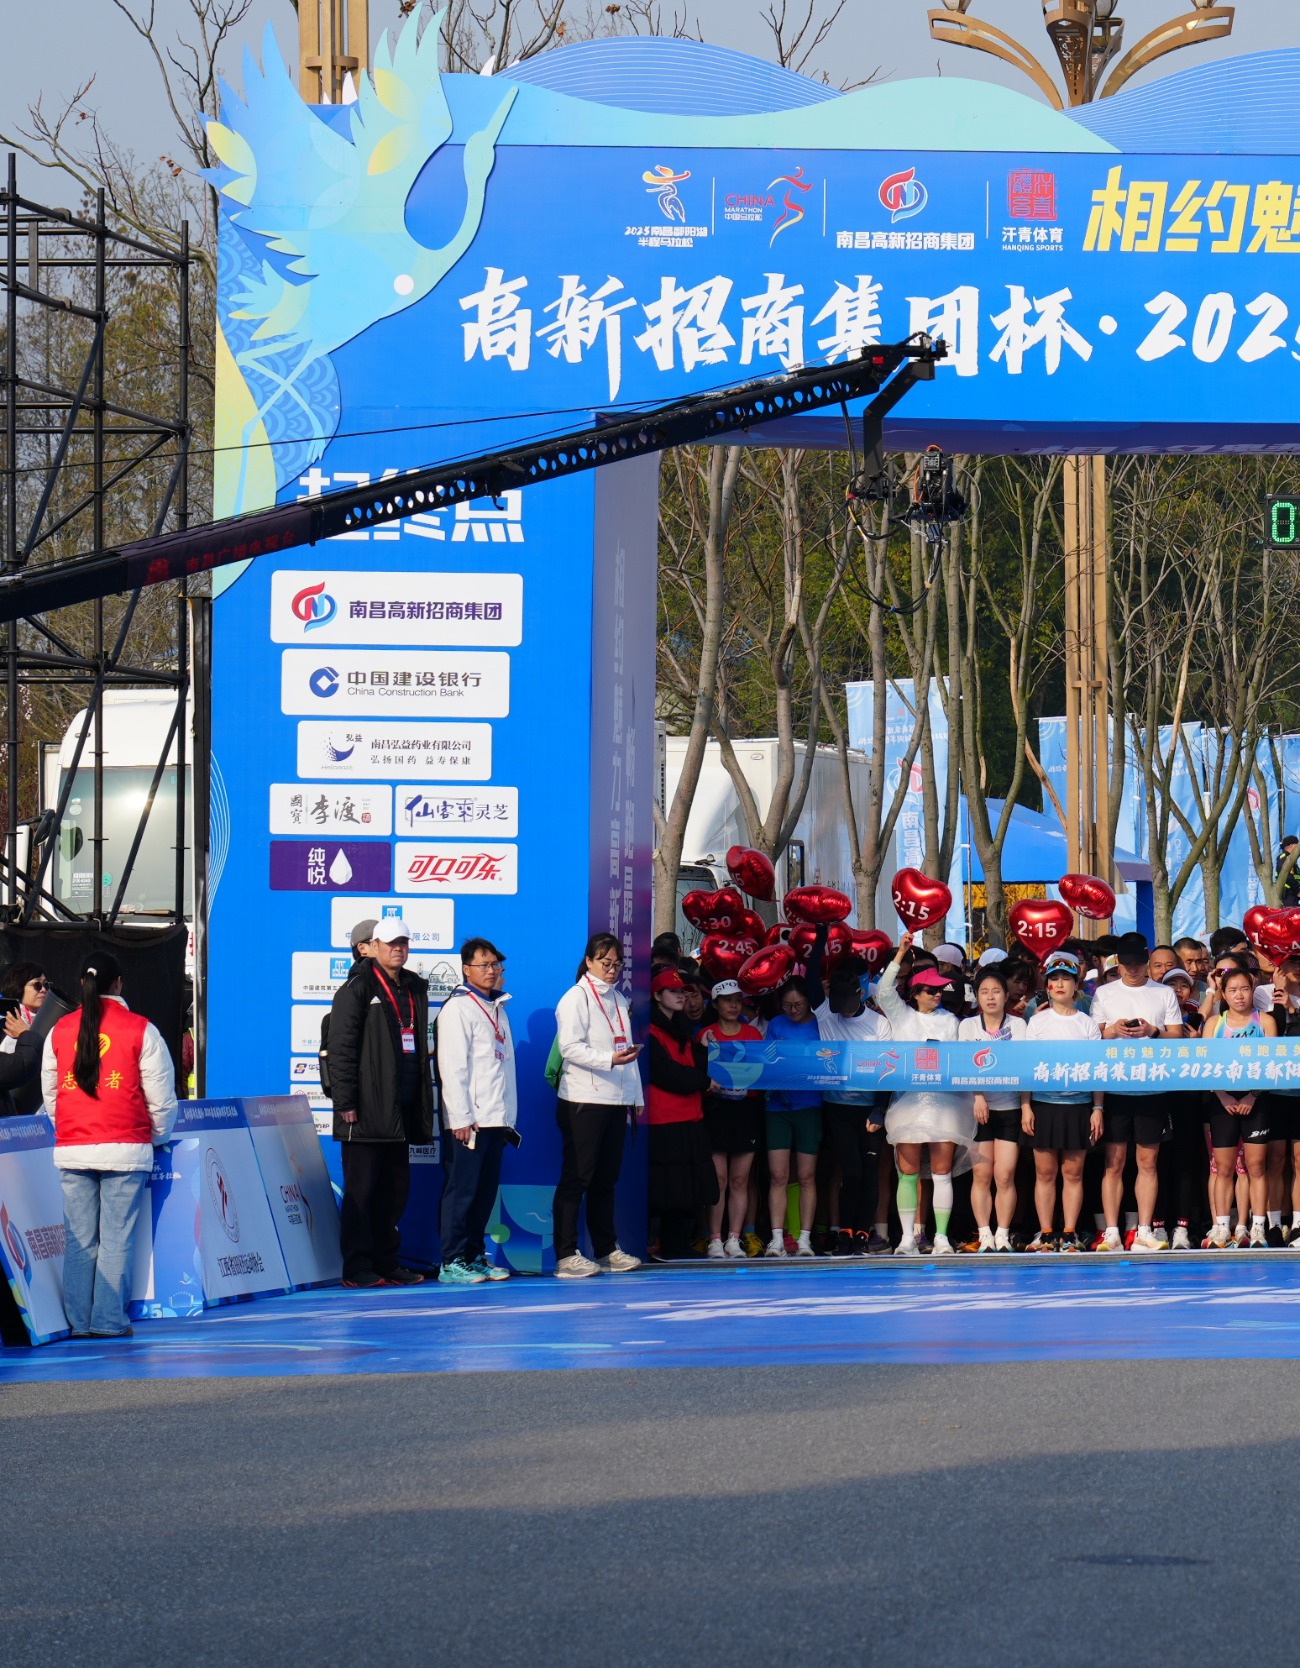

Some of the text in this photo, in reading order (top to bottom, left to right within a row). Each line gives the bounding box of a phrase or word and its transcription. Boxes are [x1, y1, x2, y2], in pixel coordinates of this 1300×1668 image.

[725, 193, 775, 207] CHINA
[637, 237, 694, 248] 半程马拉松
[836, 231, 975, 251] 南昌高新招商集团
[1002, 226, 1064, 243] 汗青体育
[1002, 244, 1064, 252] HANQING SPORTS
[349, 601, 503, 621] 南昌高新招商集团
[347, 671, 482, 687] 中国建设银行
[347, 687, 465, 697] China Construction Bank
[371, 739, 471, 751] 南昌弘益药业有限公司
[307, 847, 327, 885] 纯悦
[408, 852, 507, 883] 可口可乐
[893, 891, 930, 921] 2:15
[692, 915, 732, 931] 2:30
[1017, 920, 1057, 938] 2:15
[718, 939, 754, 956] 2:45
[1105, 1045, 1209, 1060] 相约魅力高新
[62, 1070, 124, 1090] 志者
[911, 1073, 943, 1082] 汗青体育
[952, 1076, 1020, 1086] 南昌高新招商集团
